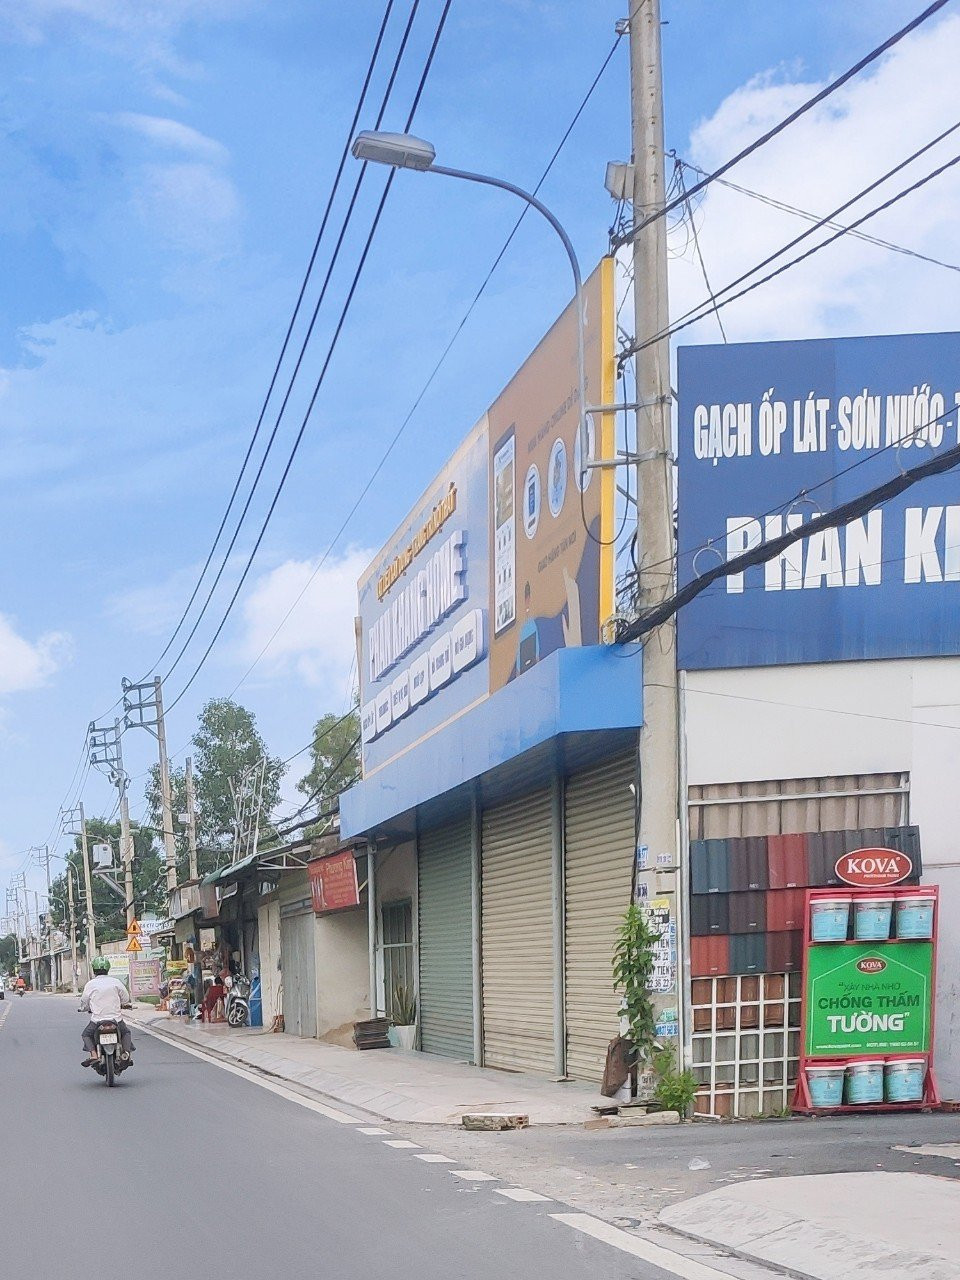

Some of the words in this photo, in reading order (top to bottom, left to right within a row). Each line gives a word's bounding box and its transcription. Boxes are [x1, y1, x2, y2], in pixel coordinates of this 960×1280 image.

[693, 403, 752, 466] GẠCH
[758, 387, 787, 456] ỐP
[793, 391, 830, 453] LÁT
[837, 388, 881, 451] SƠN
[886, 383, 945, 449] NƯỚC
[726, 509, 883, 594] PHAN
[846, 858, 900, 874] KOVA
[860, 960, 882, 969] KOVA
[818, 992, 872, 1009] CHỐNG
[876, 990, 920, 1008] THẤM
